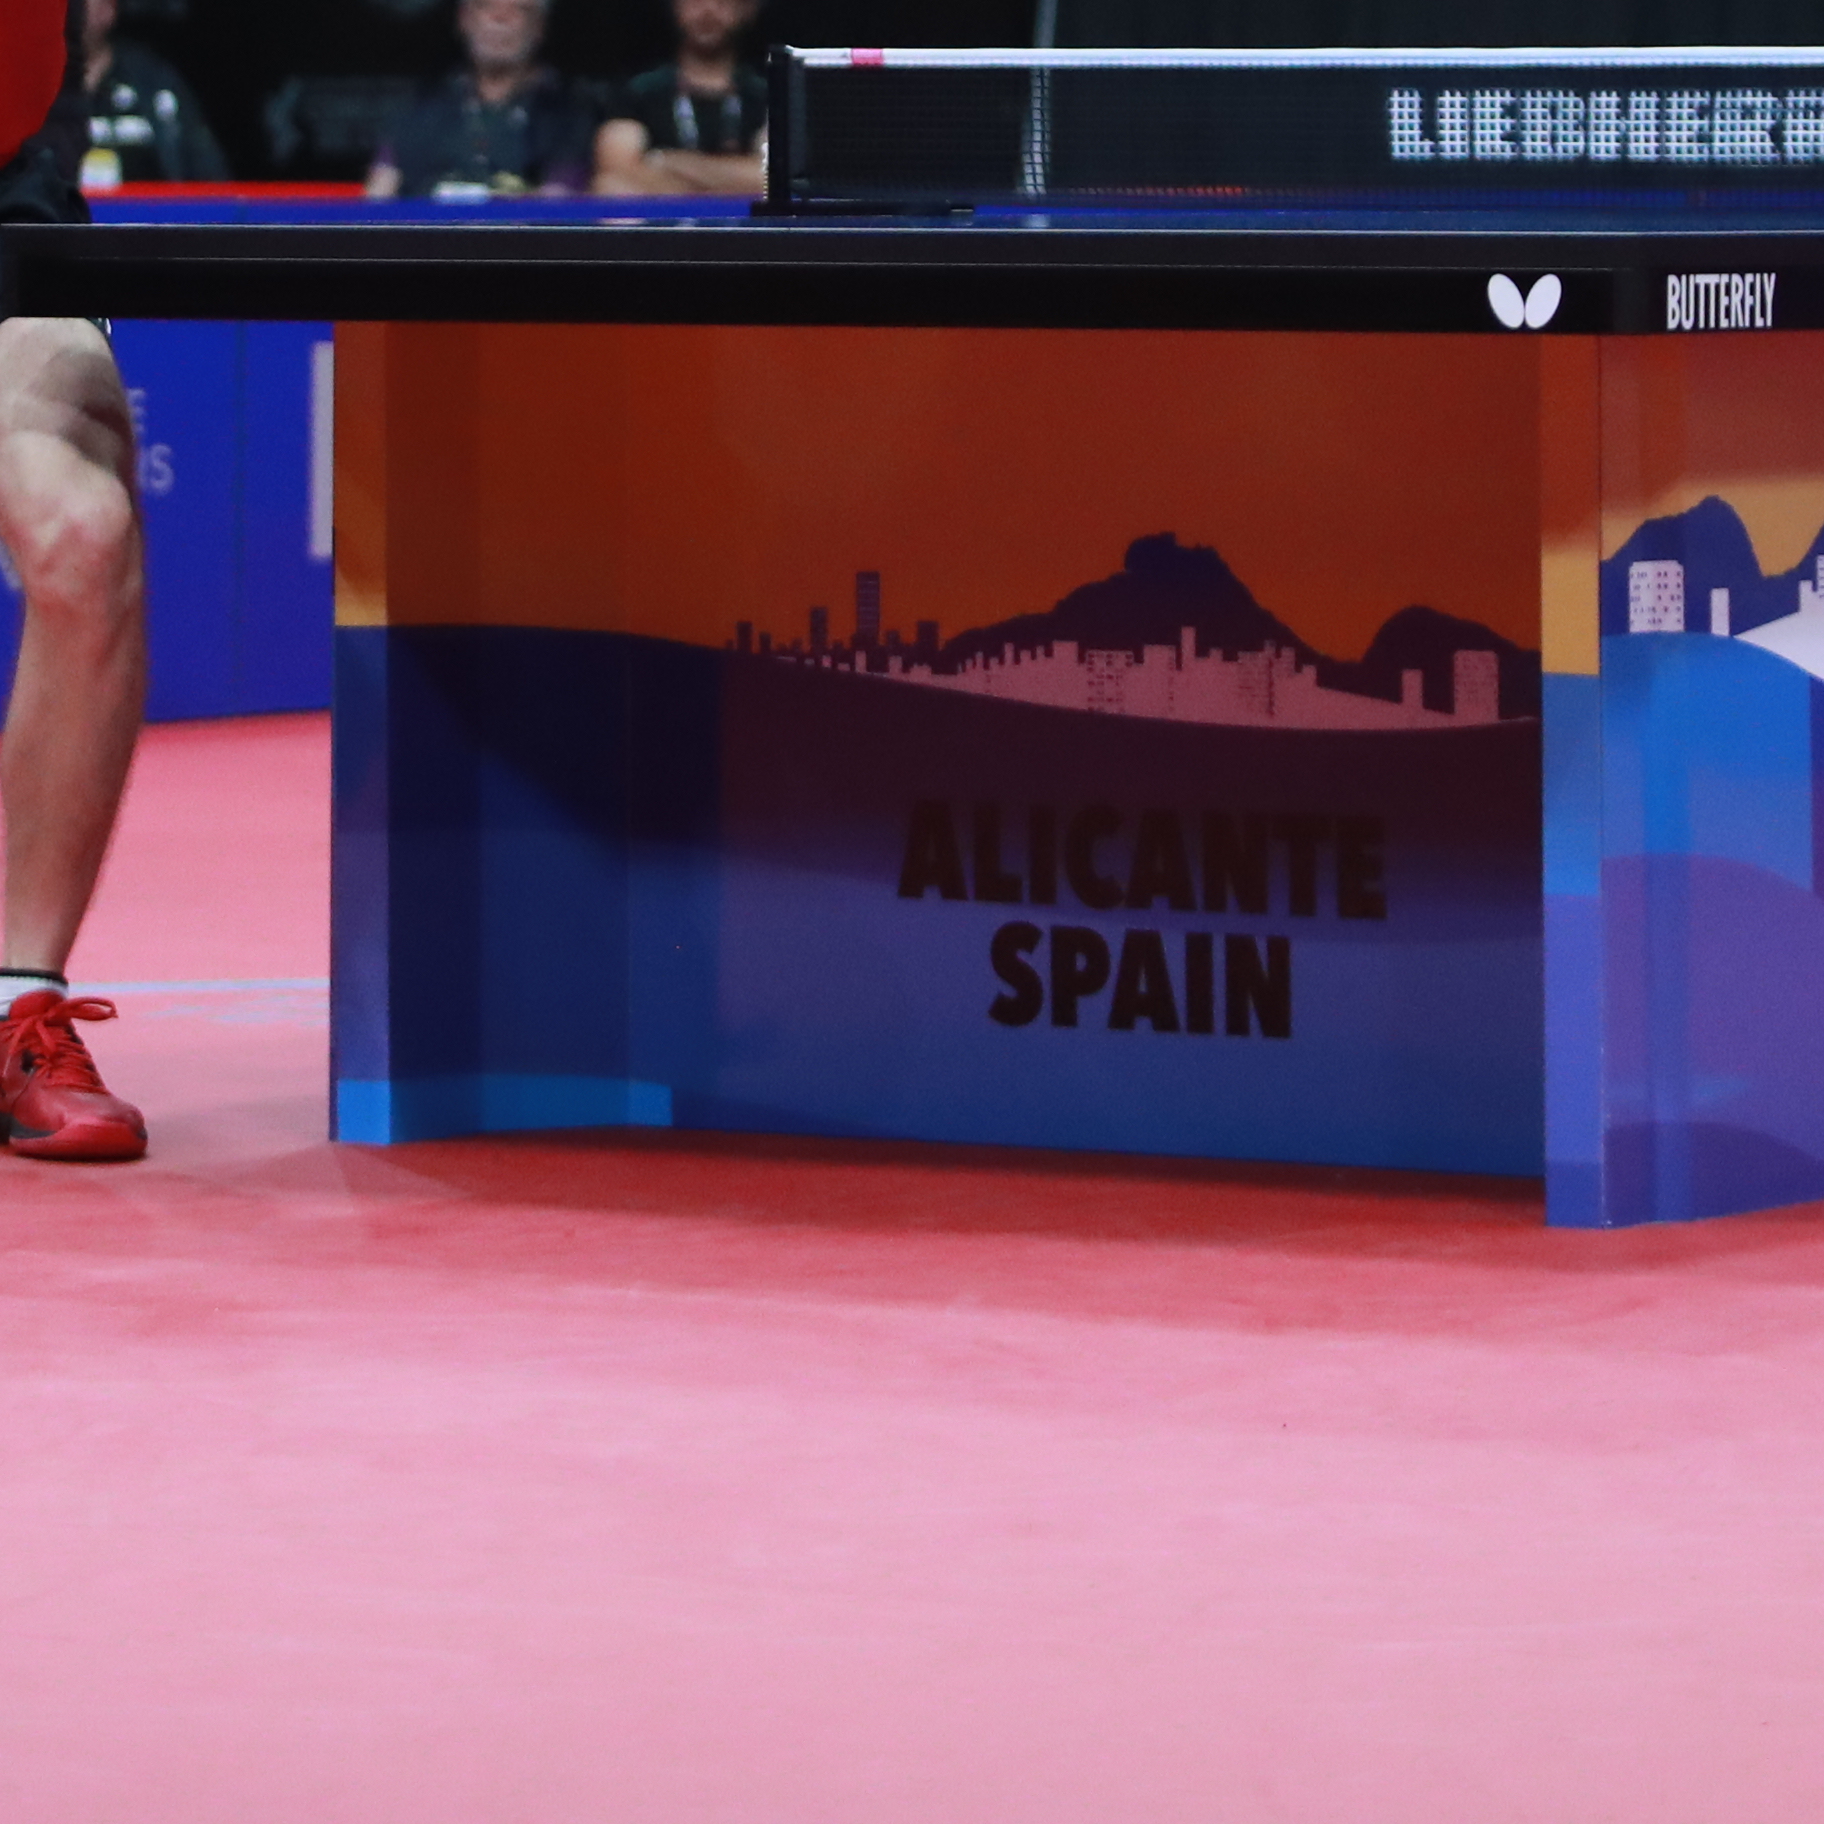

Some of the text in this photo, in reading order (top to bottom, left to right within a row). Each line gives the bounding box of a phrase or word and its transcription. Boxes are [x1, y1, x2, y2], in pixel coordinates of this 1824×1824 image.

[1665, 272, 1776, 330] BUTTERFLY
[896, 797, 1388, 920] ALICANTE
[986, 920, 1293, 1039] SPAIN
